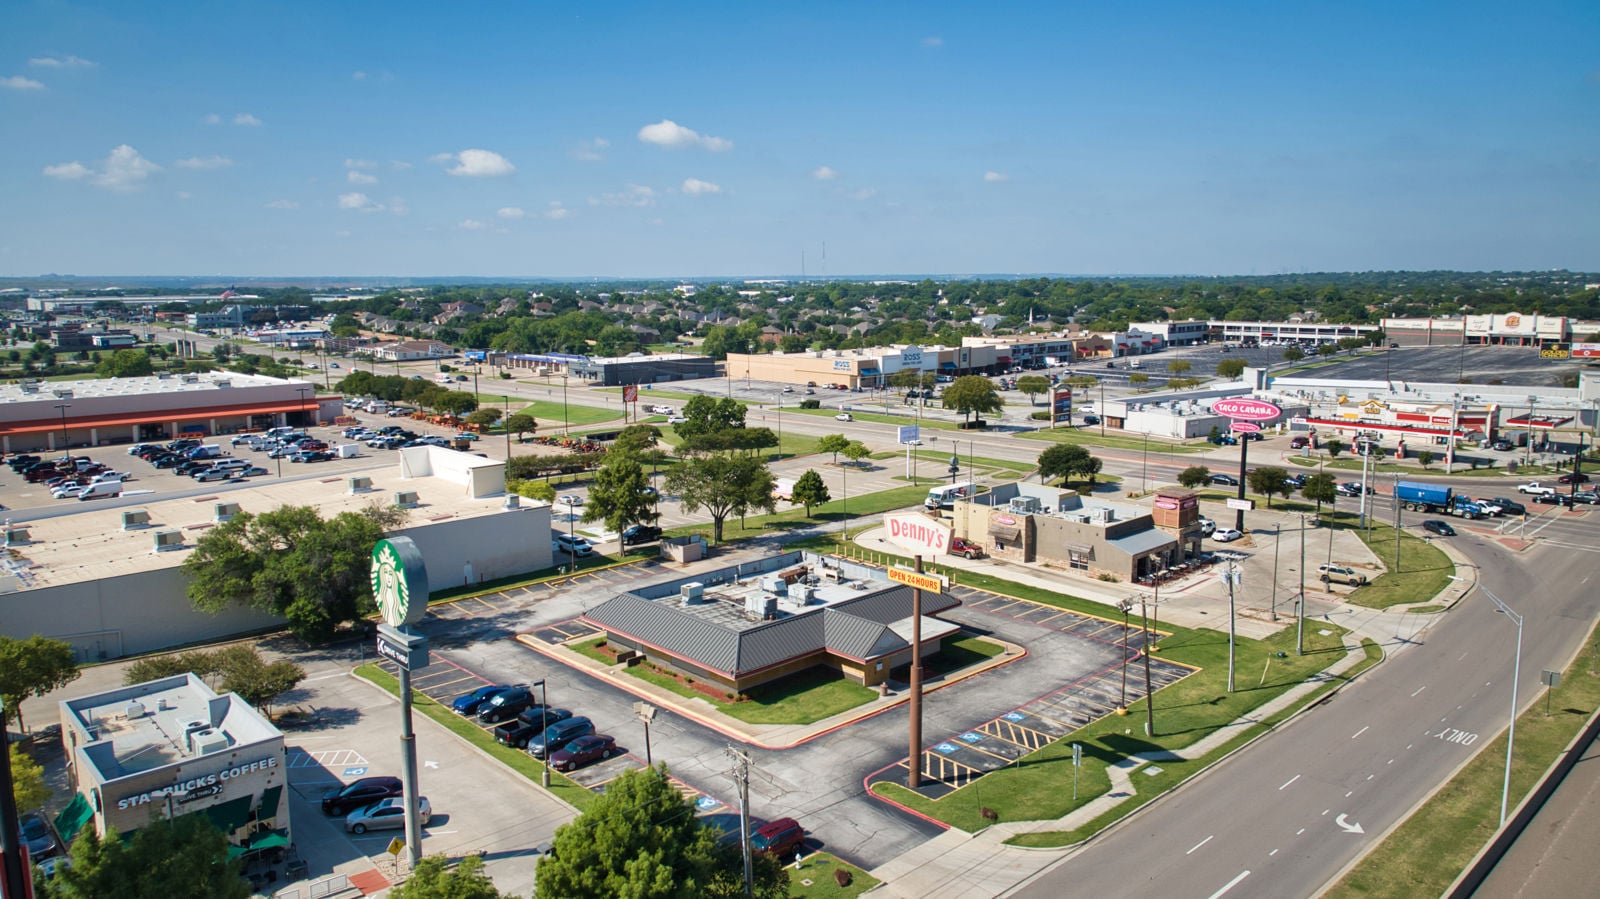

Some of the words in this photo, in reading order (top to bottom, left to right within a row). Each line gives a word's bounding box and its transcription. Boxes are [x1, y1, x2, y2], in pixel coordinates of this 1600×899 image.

[904, 353, 920, 361] ROSS
[1218, 404, 1238, 412] TACO
[1240, 405, 1272, 415] CABANA
[890, 518, 944, 549] Denny's
[889, 569, 906, 581] OPEN
[907, 575, 915, 584] 24
[916, 577, 938, 590] HOURS
[1433, 727, 1478, 745] ONLY
[118, 774, 216, 810] STABUCKS
[220, 757, 276, 781] COFFEE
